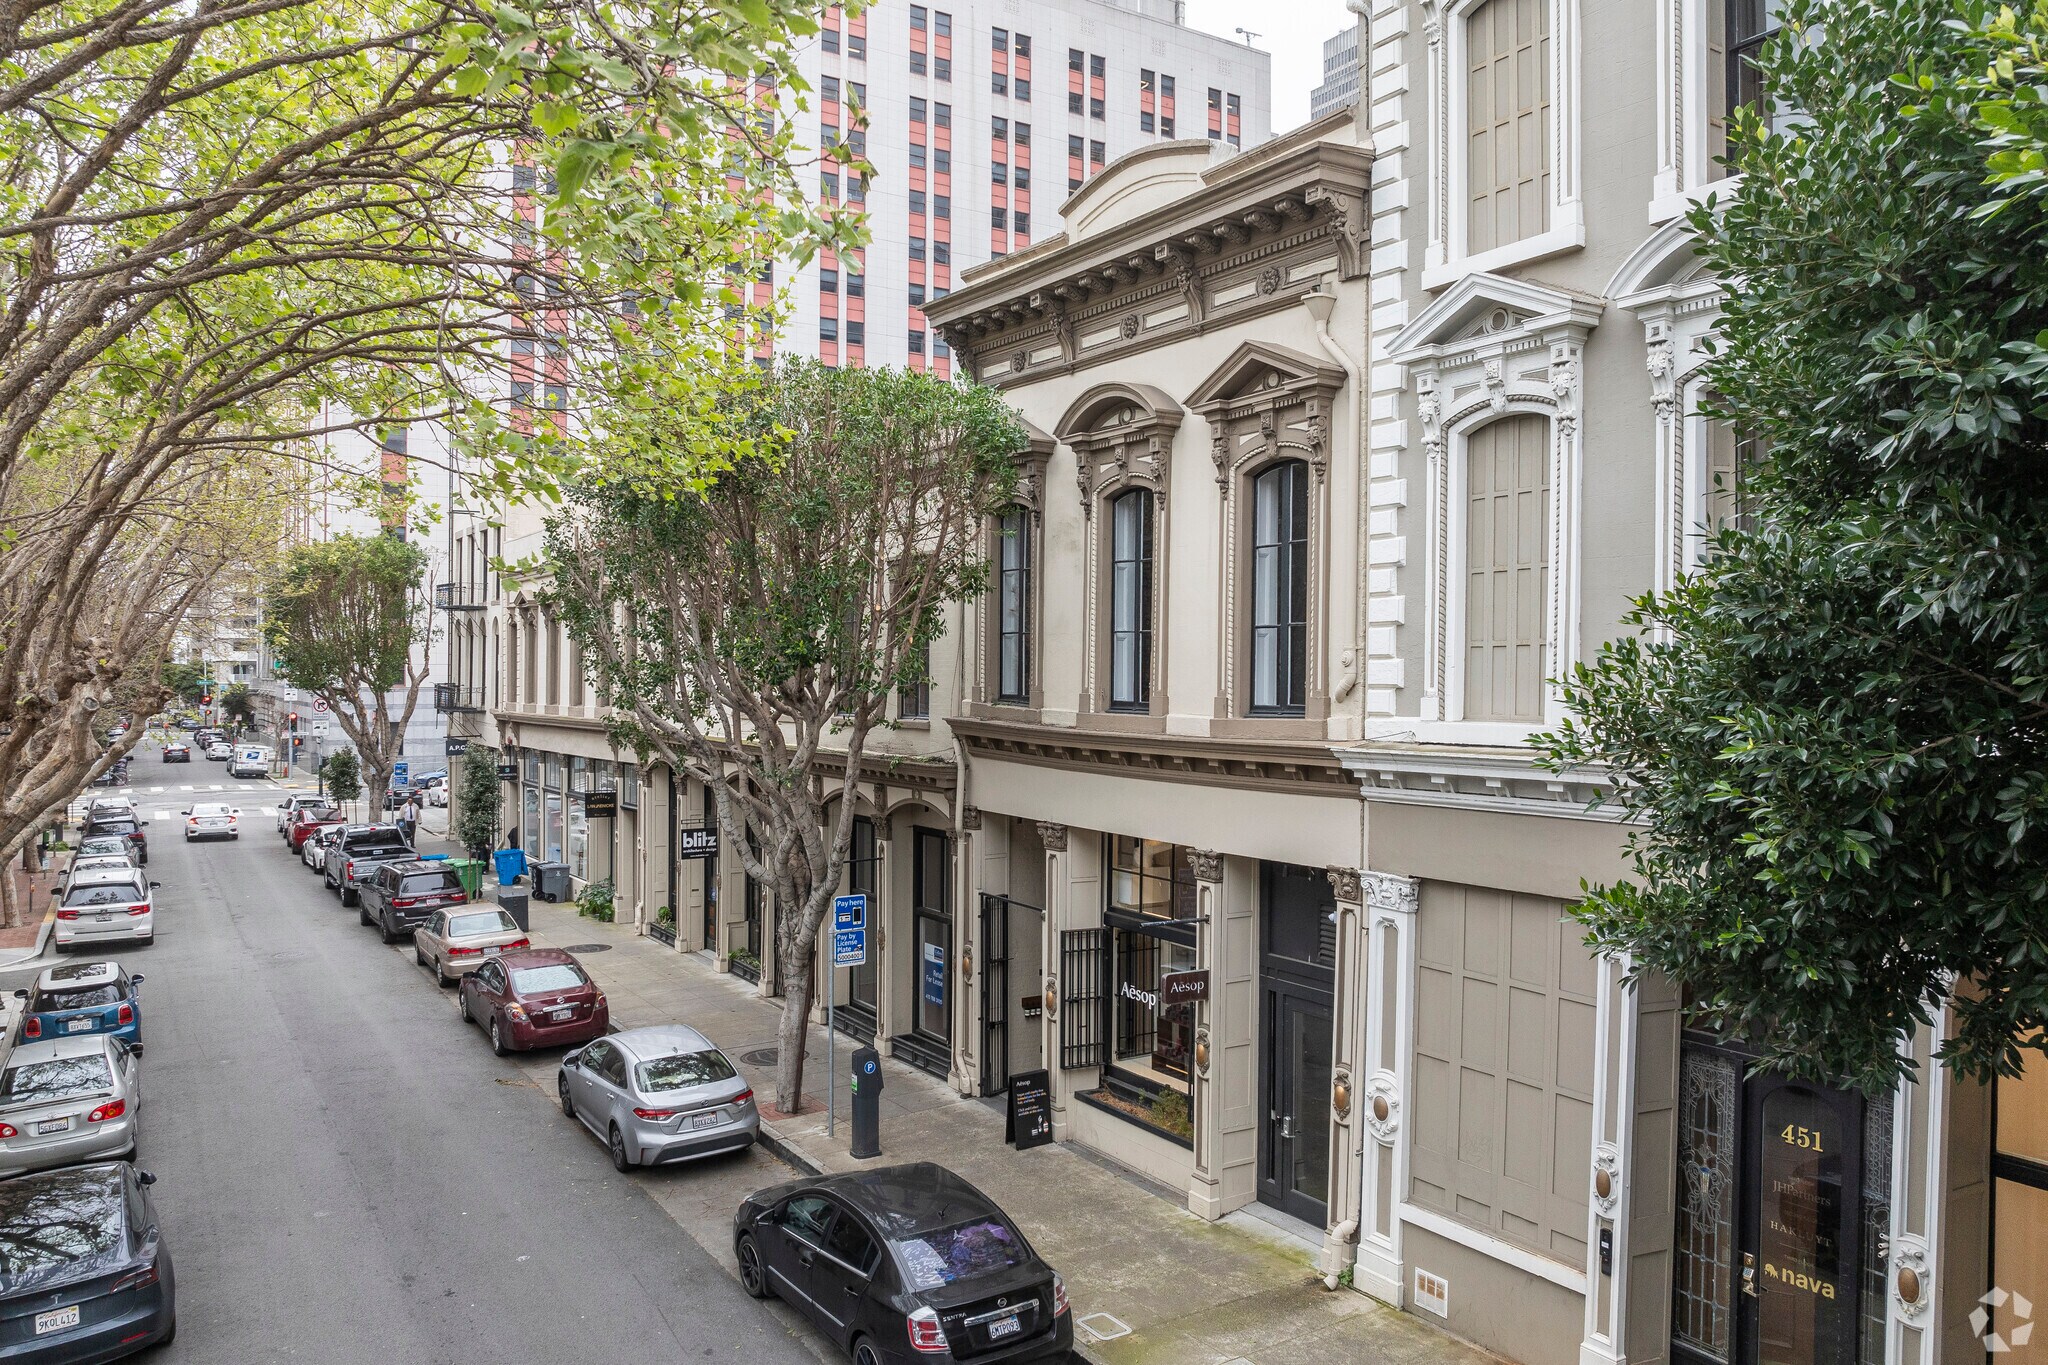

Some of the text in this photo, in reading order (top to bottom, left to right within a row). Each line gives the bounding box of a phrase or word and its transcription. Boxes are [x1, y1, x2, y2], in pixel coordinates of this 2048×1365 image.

[682, 831, 717, 848] blitz
[837, 900, 849, 908] Pay
[1781, 1124, 1824, 1153] 451
[1772, 1180, 1832, 1208] JHPartners
[1769, 1220, 1833, 1248] HAKLUYT
[1781, 1267, 1835, 1300] nava
[942, 1312, 967, 1323] SENTRA
